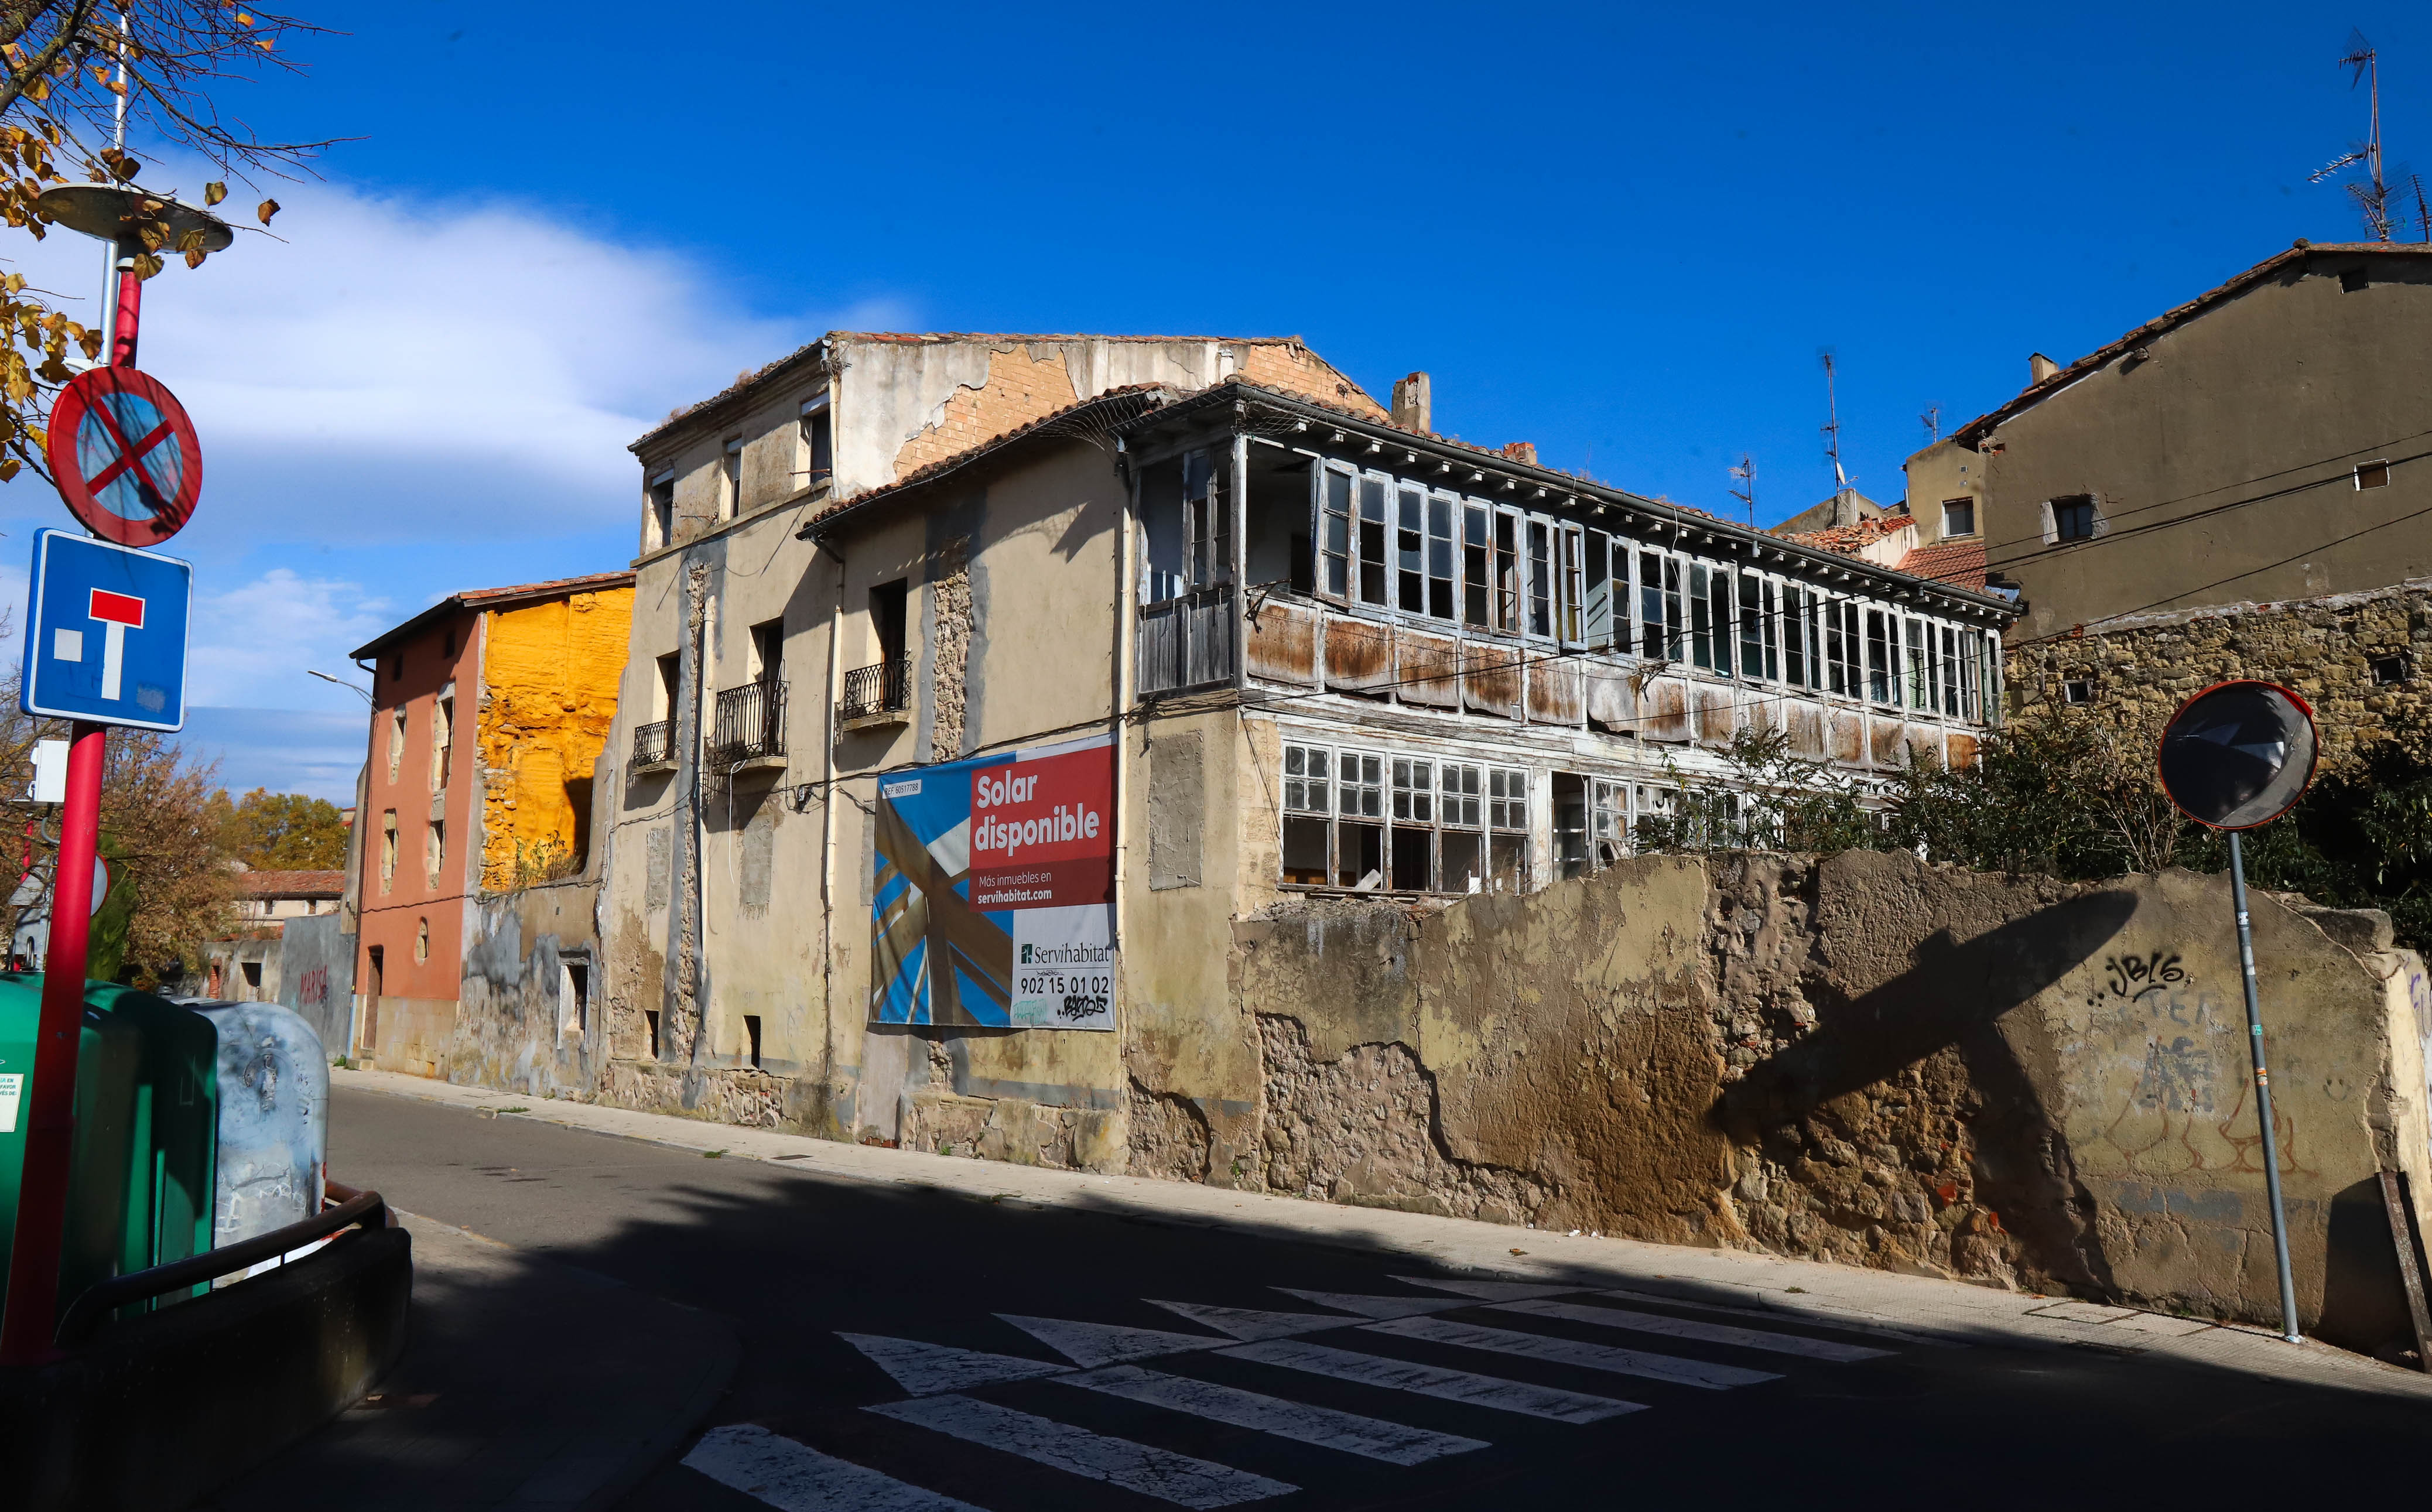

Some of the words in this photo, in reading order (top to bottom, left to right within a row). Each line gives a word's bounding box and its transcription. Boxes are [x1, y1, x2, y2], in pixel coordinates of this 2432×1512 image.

[895, 782, 919, 794] 60517788
[977, 769, 1038, 809] Solar
[975, 802, 1100, 857] disponible
[979, 875, 996, 888] Más
[997, 871, 1039, 886] inmuebles
[1041, 872, 1052, 882] en
[977, 888, 1052, 905] servihabitat.com
[1035, 942, 1110, 964] Servihabitat
[1021, 977, 1044, 994] 902
[1049, 977, 1065, 994] 15
[1070, 976, 1086, 994] 01
[1092, 976, 1109, 994] 02
